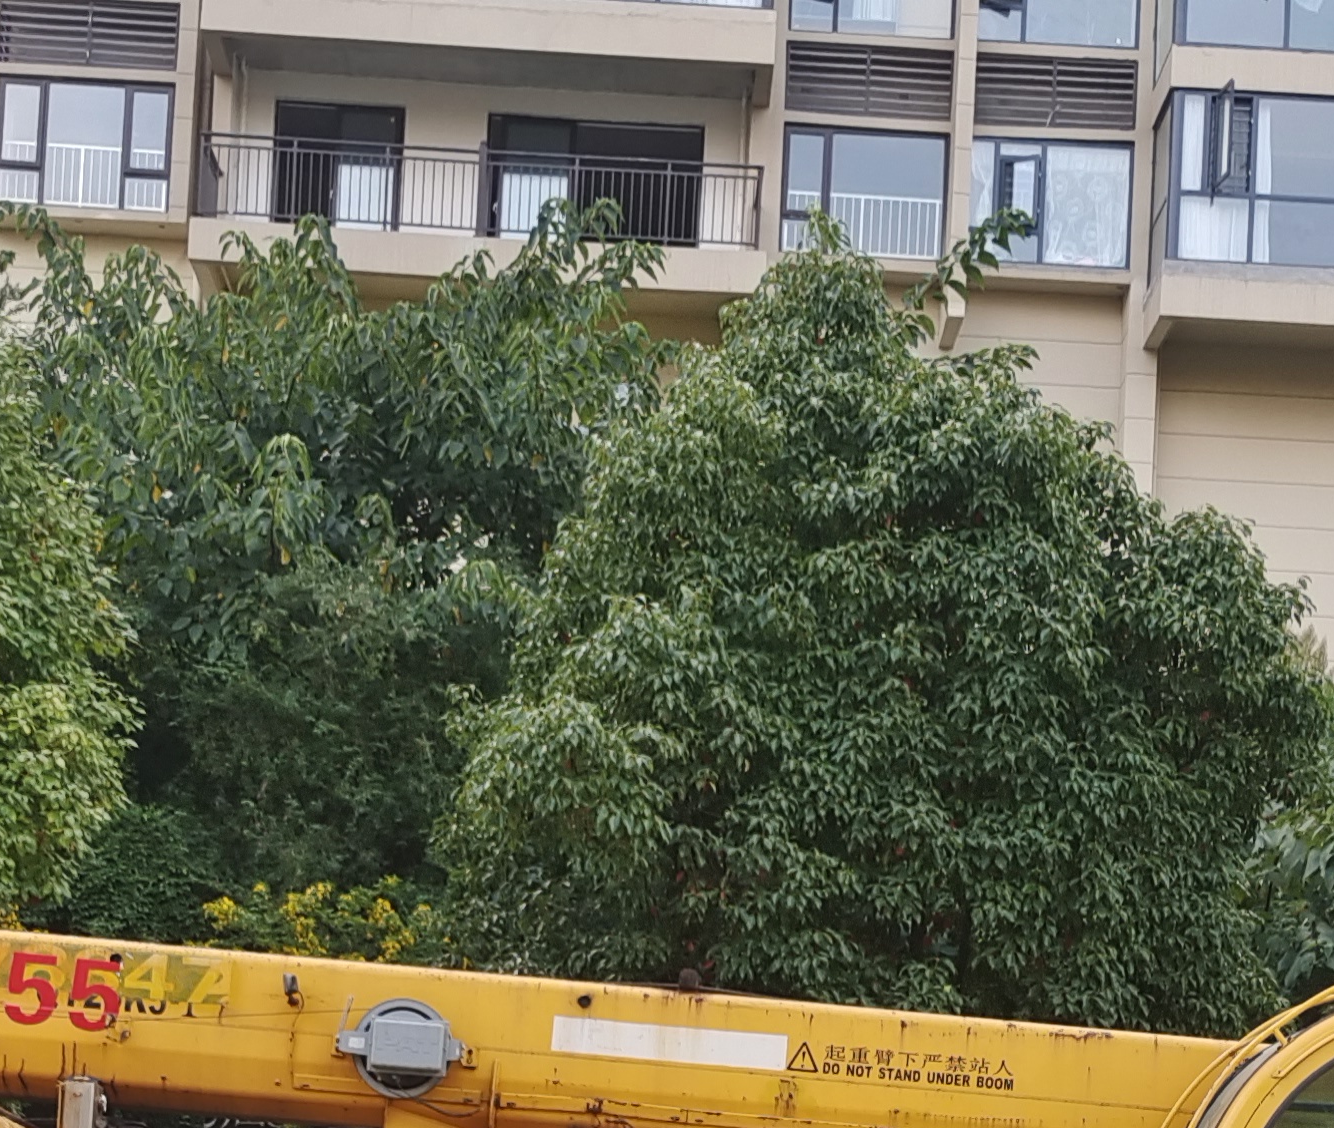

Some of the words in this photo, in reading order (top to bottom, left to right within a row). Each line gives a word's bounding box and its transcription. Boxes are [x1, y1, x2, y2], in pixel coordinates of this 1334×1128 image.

[824, 1044, 1014, 1076] 起重臂下严禁站人
[822, 1062, 840, 1075] DO
[846, 1064, 873, 1078] NOT
[878, 1067, 921, 1083] STAND
[927, 1071, 970, 1087] UNDER
[976, 1076, 1014, 1091] BOOM
